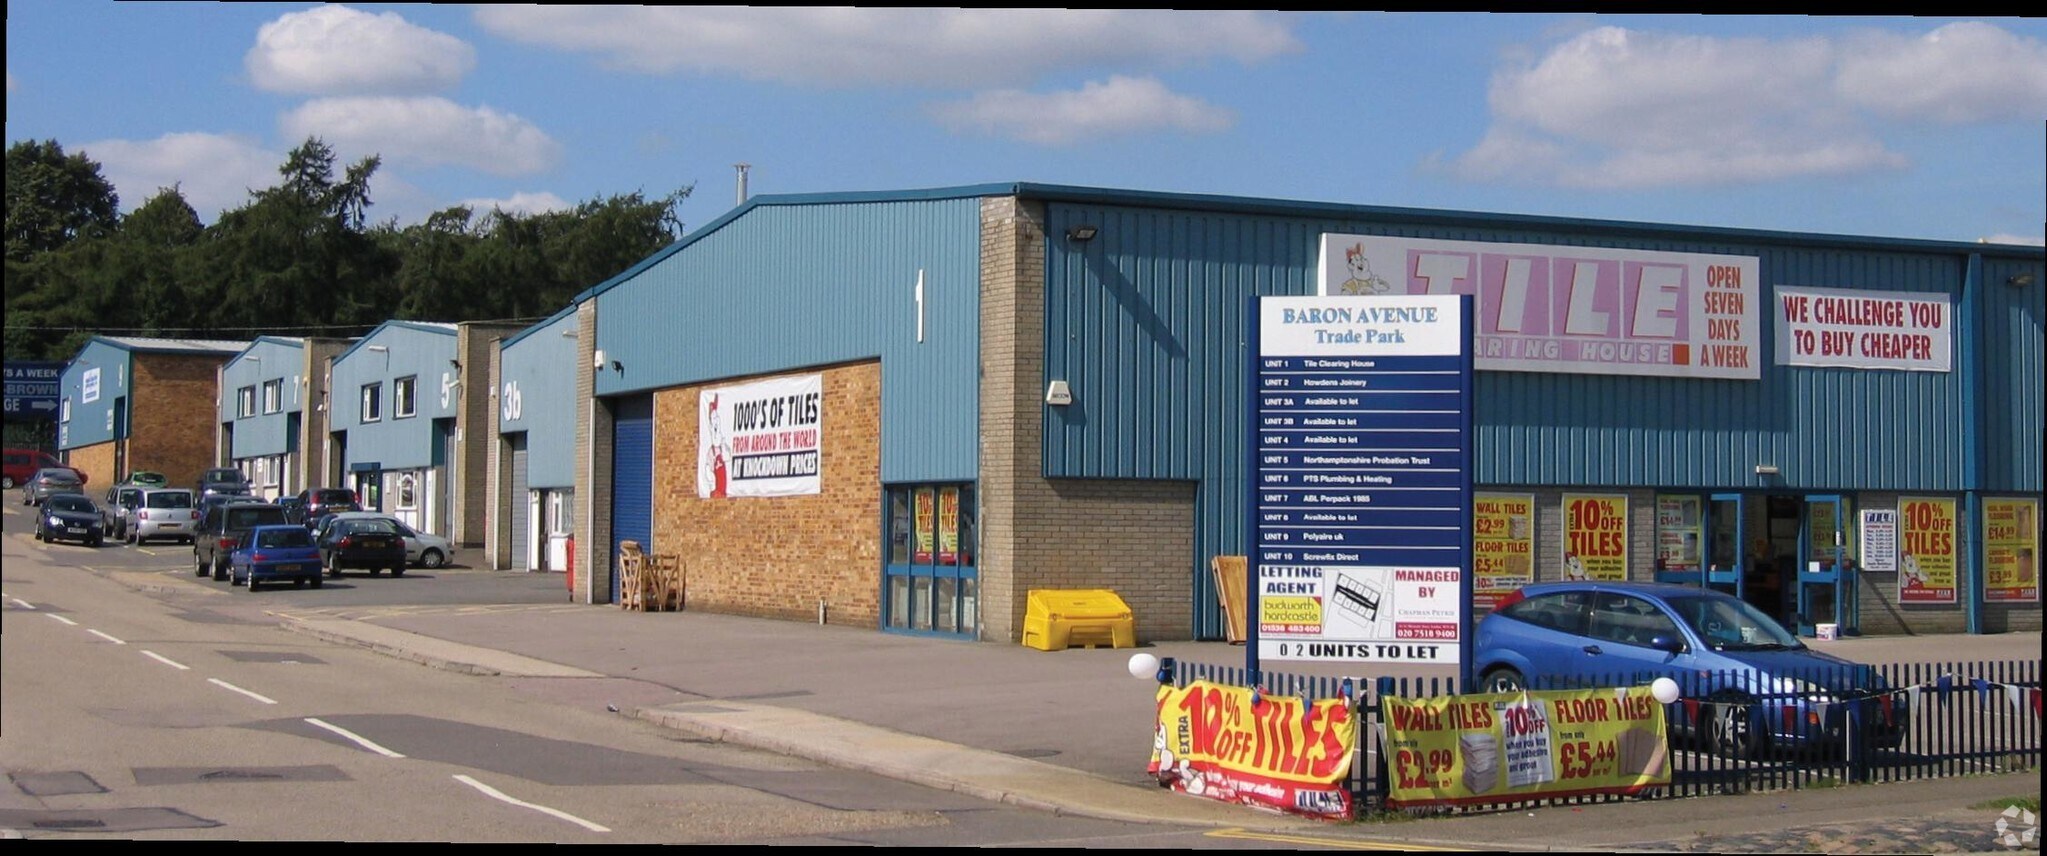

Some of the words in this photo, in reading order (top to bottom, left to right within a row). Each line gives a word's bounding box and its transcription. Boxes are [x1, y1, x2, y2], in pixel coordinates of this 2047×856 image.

[1706, 265, 1741, 288] OPEN
[915, 269, 923, 342] 1
[1704, 291, 1744, 316] SEVEN
[1784, 296, 1808, 322] WE
[1814, 297, 1904, 328] CHALLENGE
[1909, 302, 1942, 328] YOU
[1282, 308, 1352, 324] BARON
[1356, 306, 1438, 324] AVENUE
[1314, 329, 1362, 344] Trade
[1366, 329, 1406, 344] Park
[1708, 318, 1740, 341] DAYS
[1580, 342, 1672, 364] HOUSE
[1794, 329, 1815, 355] TO
[1822, 330, 1854, 356] BUY
[1860, 333, 1932, 360] CHEAPER
[1319, 360, 1350, 368] Clearing
[1700, 344, 1714, 367] A
[1713, 345, 1748, 368] WEEK
[4, 369, 13, 377] S
[16, 369, 24, 377] A
[27, 369, 58, 378] WEEK
[1340, 379, 1366, 388] Joinery
[293, 376, 299, 404] 7
[440, 372, 449, 409] 5
[504, 381, 522, 421] 3b
[733, 399, 767, 432] 1000'S
[770, 397, 784, 428] OF
[788, 392, 818, 426] TILES
[732, 436, 750, 454] FROM
[751, 433, 776, 452] AROUND
[780, 432, 791, 449] THE
[794, 429, 816, 448] WORLD
[733, 458, 742, 479] AT
[743, 455, 788, 478] KNOCKDOWN
[790, 452, 816, 475] PRICES
[1304, 456, 1371, 464] Northamptonshire
[1320, 475, 1354, 484] Plumbing
[1364, 476, 1392, 484] Heating
[1476, 503, 1500, 514] WALL
[1504, 504, 1526, 514] TILES
[1476, 519, 1505, 534] £2.99
[1601, 517, 1623, 530] OFF
[1933, 519, 1952, 531] OFF
[1476, 542, 1503, 552] FLOOR
[1507, 543, 1528, 553] TILES
[1569, 532, 1622, 556] TILES
[1904, 532, 1951, 555] TILES
[1261, 566, 1322, 578] LETTING
[1395, 571, 1459, 582] MANAGED
[1266, 582, 1316, 594] AGENT
[1419, 587, 1435, 598] BY
[1264, 597, 1314, 610] budworth
[1264, 611, 1318, 621] hardcastle
[1280, 643, 1287, 656] 0
[1296, 644, 1303, 656] 2
[1309, 644, 1369, 658] UNITS
[1376, 645, 1403, 658] TO
[1407, 646, 1439, 659] LET
[1392, 705, 1442, 731] WALL
[1448, 702, 1492, 729] TILES
[1554, 698, 1609, 724] FLOOR
[1612, 696, 1652, 721] TILES
[1178, 715, 1189, 754] EXTRA
[1528, 718, 1545, 734] OFF
[1217, 728, 1252, 764] OFF
[1251, 699, 1348, 778] TILES
[1524, 740, 1534, 748] you
[1536, 738, 1546, 746] buy
[1396, 748, 1453, 789] £2.99
[1560, 740, 1616, 779] £5.44
